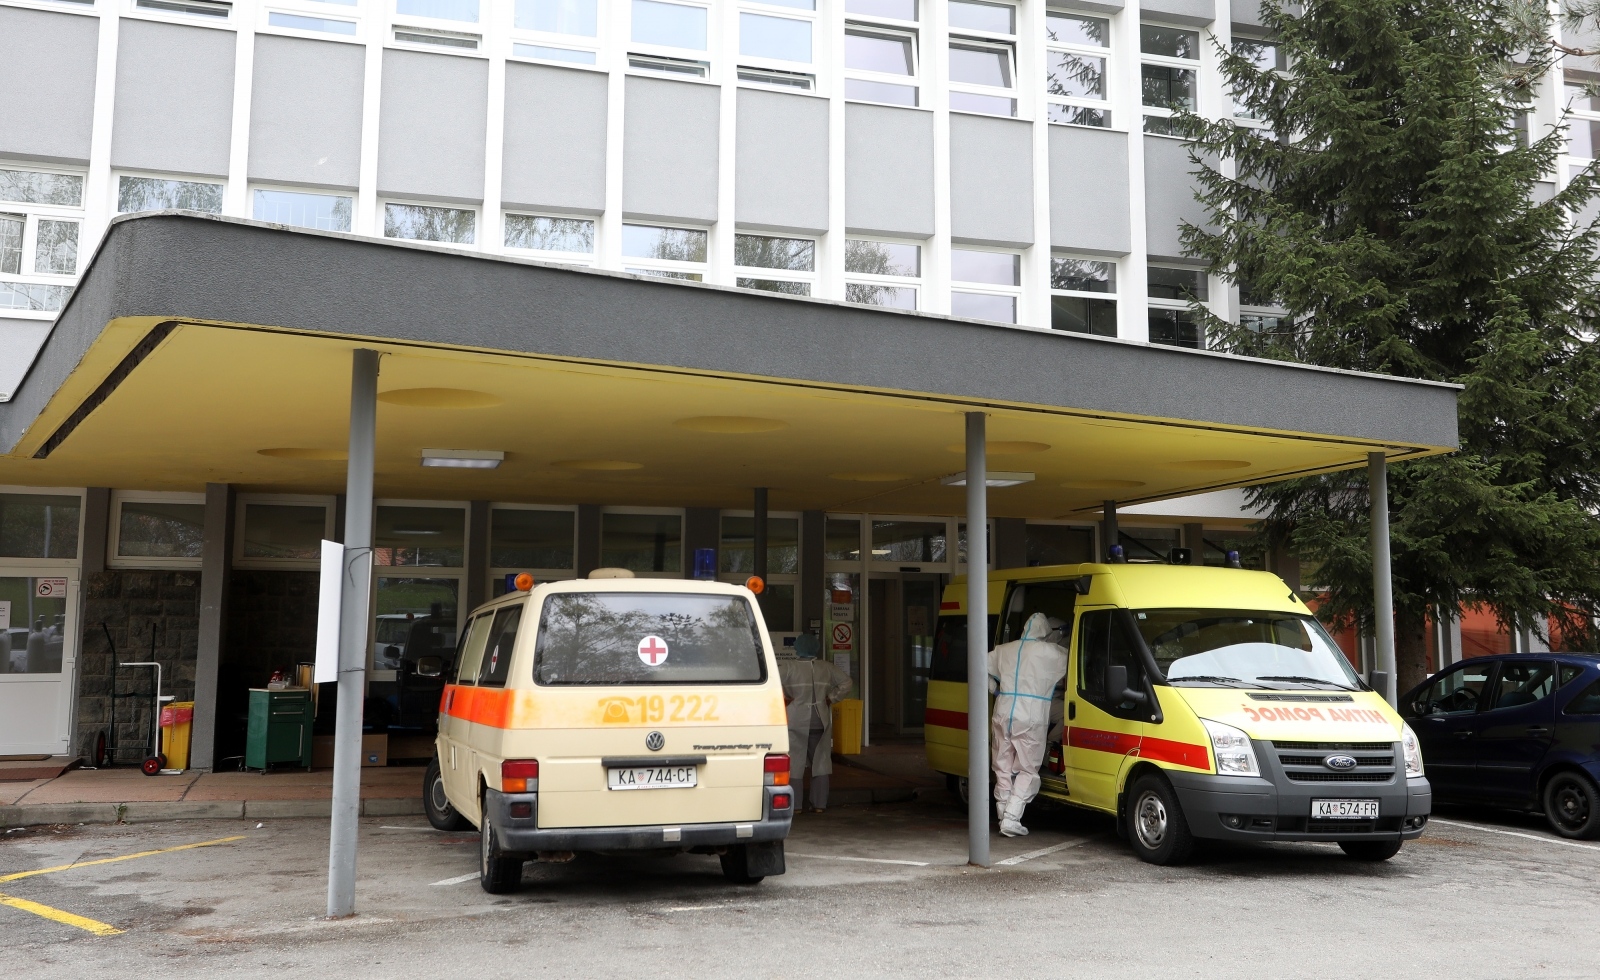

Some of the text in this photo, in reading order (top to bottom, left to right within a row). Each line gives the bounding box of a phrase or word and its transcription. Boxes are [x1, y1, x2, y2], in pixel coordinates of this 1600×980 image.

[636, 694, 720, 723] 19 222
[618, 767, 694, 785] KA 744-CF
[1319, 802, 1377, 815] KA 574-FR
